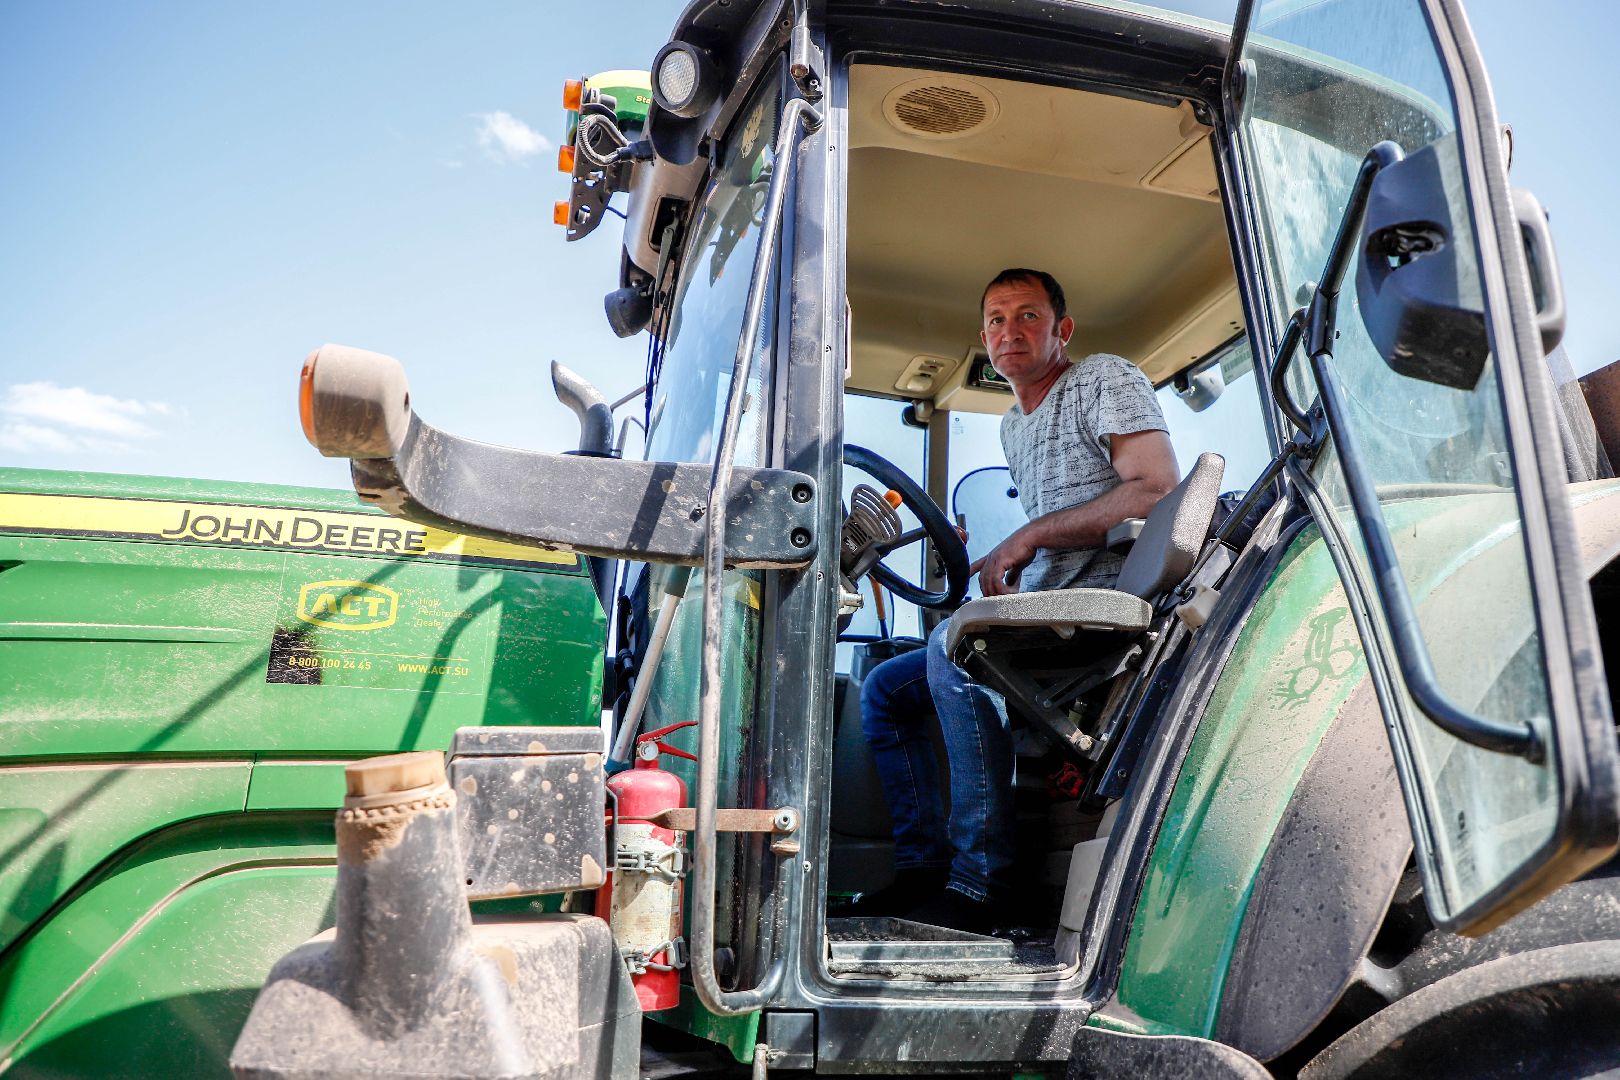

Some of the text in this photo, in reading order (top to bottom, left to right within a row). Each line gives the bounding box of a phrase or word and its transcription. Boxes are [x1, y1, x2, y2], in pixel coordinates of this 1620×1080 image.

[635, 95, 651, 104] Sta
[162, 510, 428, 552] JOHN DEERE
[310, 593, 386, 617] ACT
[289, 656, 372, 671] 8-800 100 24 45
[398, 663, 469, 677] WWW.ACT.SU
